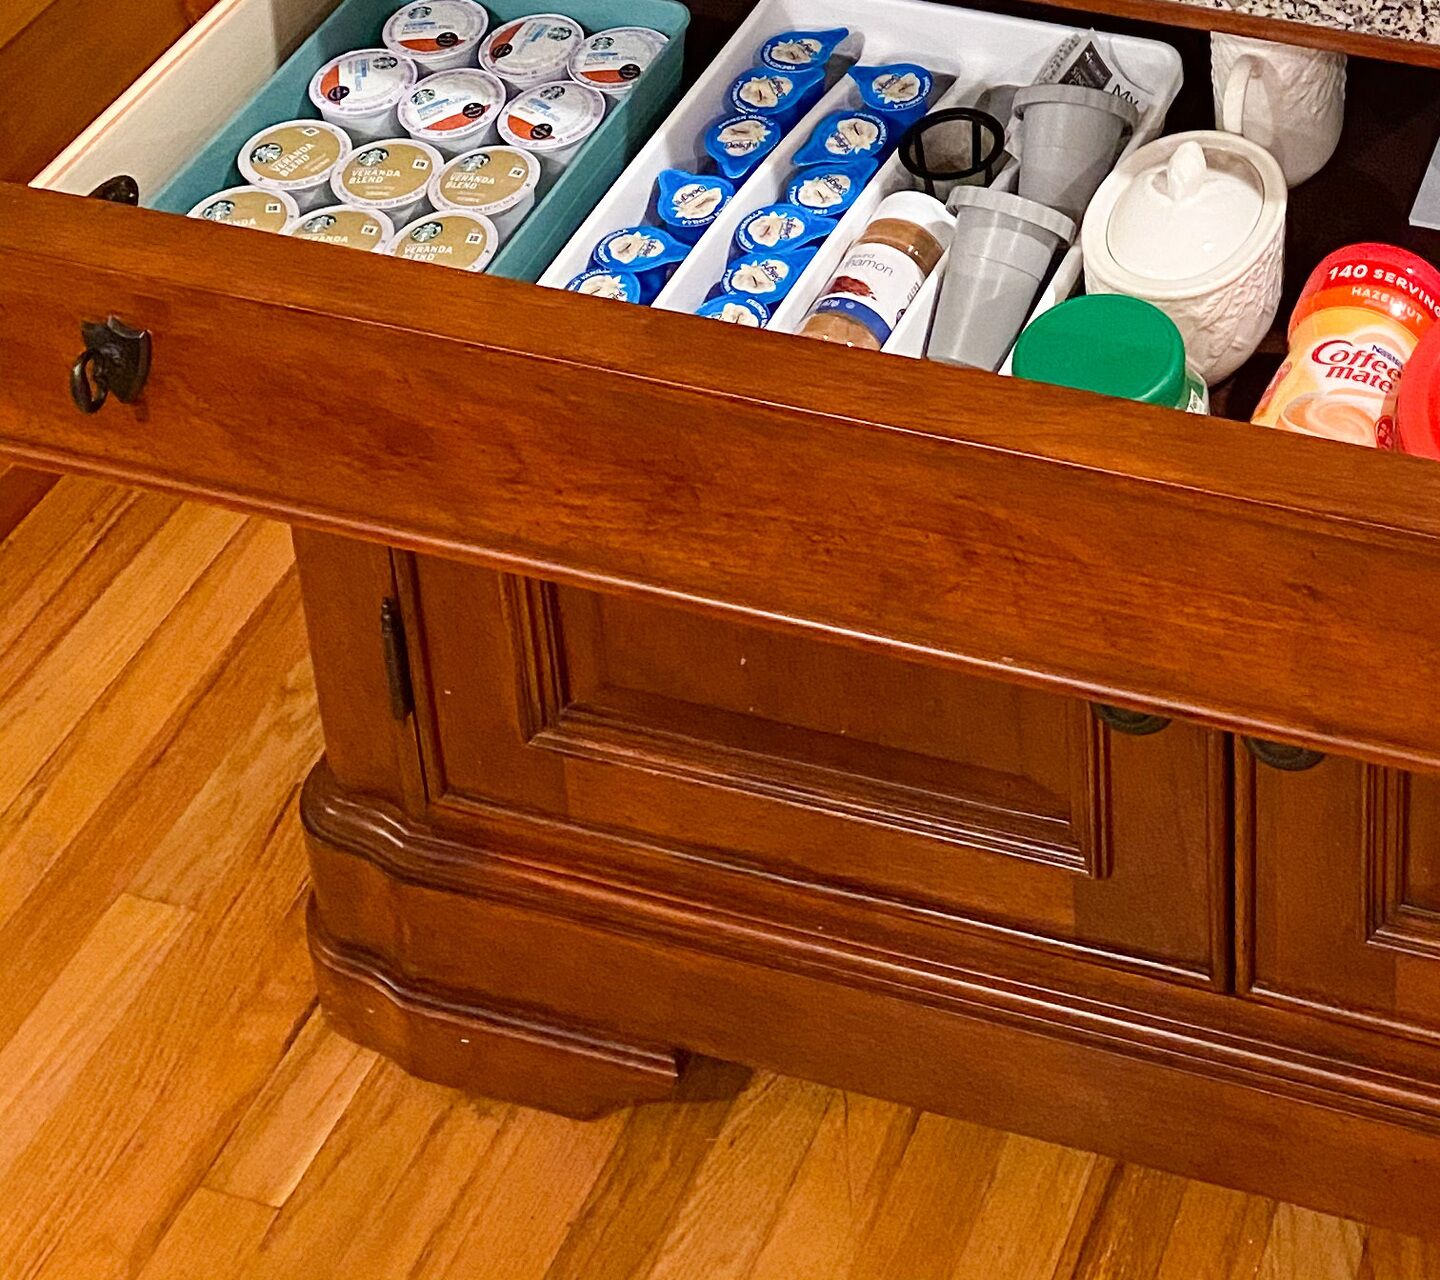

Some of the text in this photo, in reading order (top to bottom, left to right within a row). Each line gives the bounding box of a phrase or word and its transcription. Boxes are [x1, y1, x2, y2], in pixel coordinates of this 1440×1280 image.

[270, 142, 316, 172] VERANDA
[279, 154, 311, 178] BLEND
[351, 168, 401, 178] VERANDA
[348, 175, 384, 185] BLEND
[444, 181, 479, 190] BLEND
[449, 173, 496, 185] VERANDA
[404, 244, 453, 255] VERANDA
[1328, 264, 1369, 281] 140
[1311, 339, 1402, 380] Coffee
[1325, 365, 1394, 393] mate
